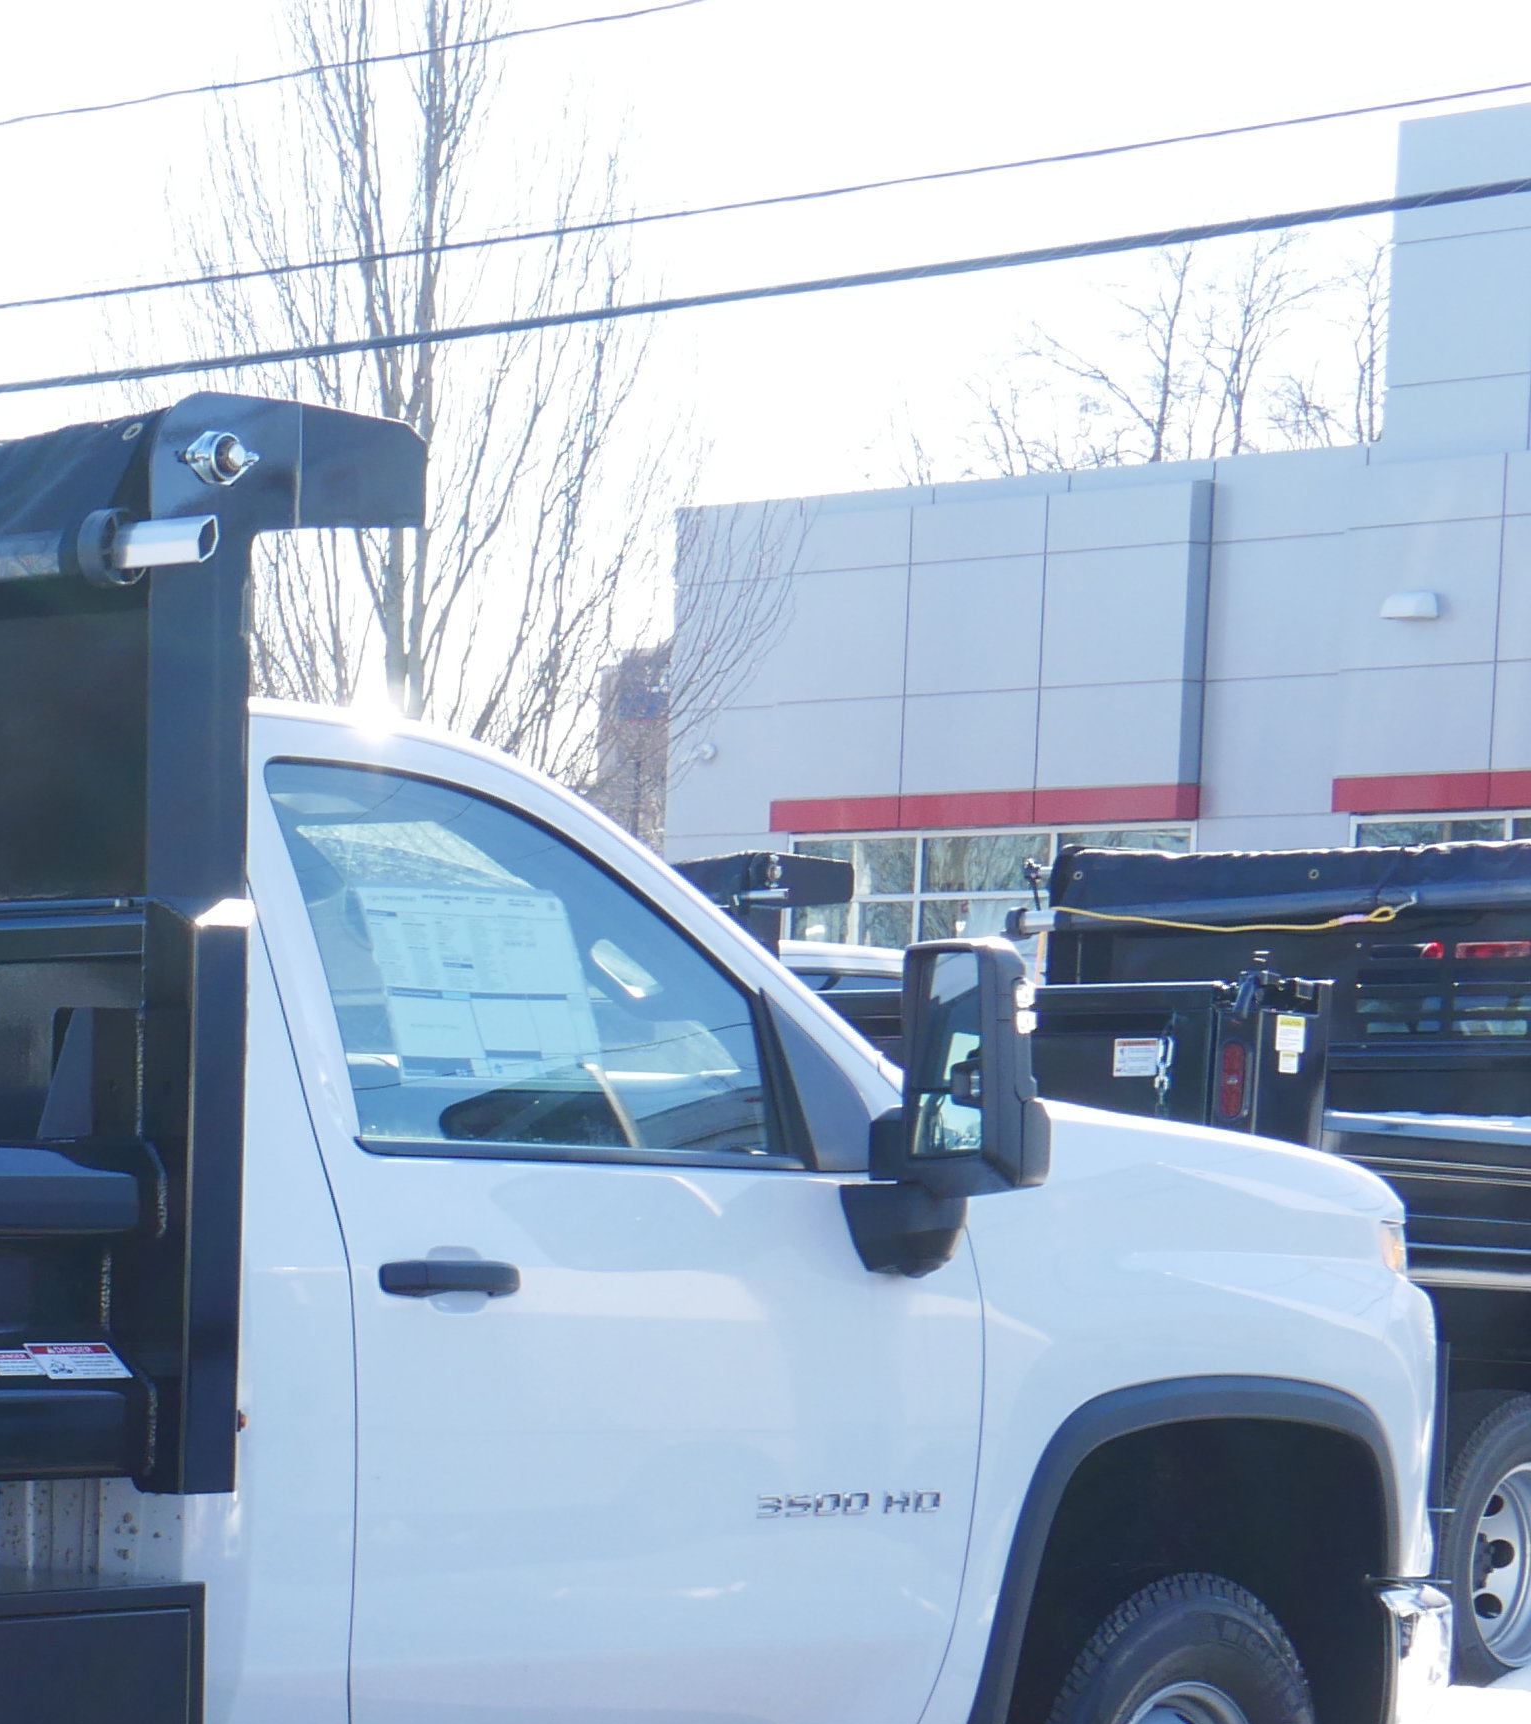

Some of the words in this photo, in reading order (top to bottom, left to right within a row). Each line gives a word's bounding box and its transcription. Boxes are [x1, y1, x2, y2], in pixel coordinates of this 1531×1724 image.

[53, 1346, 93, 1354] DANGER
[757, 1492, 870, 1519] 3500
[883, 1490, 941, 1513] HD
